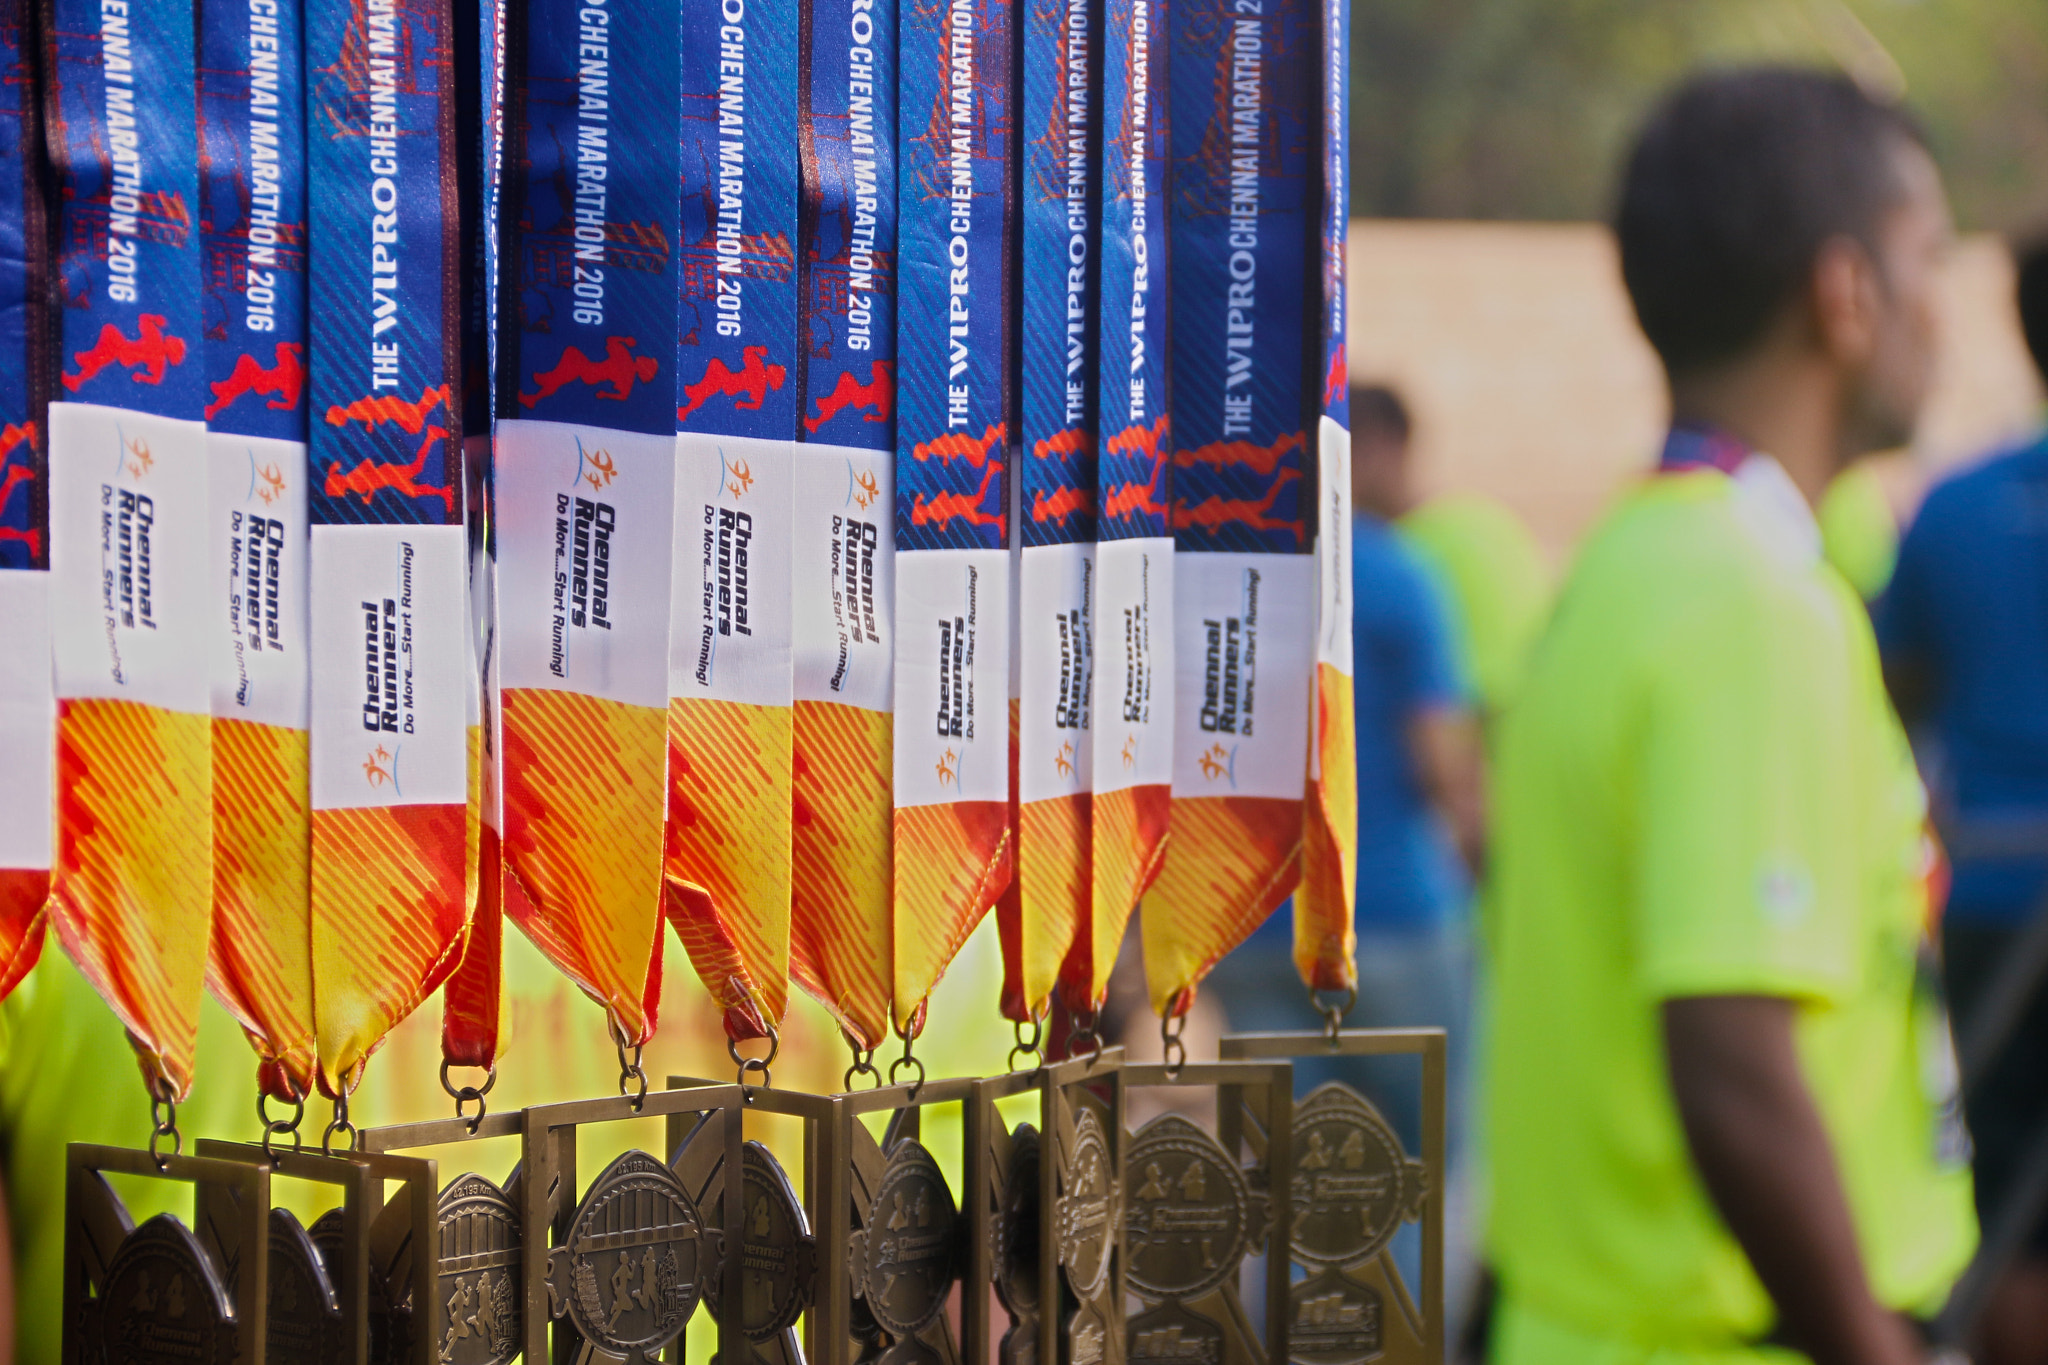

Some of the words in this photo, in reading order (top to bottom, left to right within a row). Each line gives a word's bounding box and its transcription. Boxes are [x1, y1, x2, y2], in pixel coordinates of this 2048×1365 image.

[101, 0, 133, 84] ENNAI
[248, 0, 279, 117] CHENNAI
[578, 8, 609, 120] CHENNAI
[719, 25, 745, 136] CHENNAI
[848, 46, 874, 155] CHENNAI
[951, 0, 973, 124] MARATHON
[1068, 0, 1087, 124] MARATHON
[1132, 0, 1148, 127] MARATHON
[1231, 19, 1262, 144] MARATHON
[105, 86, 140, 234] MARATHON
[369, 58, 398, 175] CHENNAI
[249, 120, 279, 265] MARATHON
[574, 124, 608, 262] MARATHON
[716, 140, 745, 274] MARATHON
[848, 158, 876, 290] MARATHON
[950, 127, 972, 233] CHENNAI
[1067, 129, 1087, 231] CHENNAI
[1131, 131, 1147, 232] CHENNAI
[1229, 148, 1259, 248] CHENNAI
[107, 237, 138, 303] 2016
[246, 269, 276, 332] 2016
[371, 177, 398, 338] WIPRO
[573, 266, 604, 326] 2016
[716, 278, 742, 337] 2016
[948, 235, 969, 381] WIPRO
[1067, 233, 1086, 376] WIPRO
[1130, 233, 1149, 375] WIPRO
[372, 341, 399, 390] THE
[847, 293, 872, 351] 2016
[1226, 250, 1256, 388] WIPRO
[948, 384, 969, 428] THE
[1066, 380, 1083, 424] THE
[1129, 378, 1146, 421] THE
[1224, 395, 1252, 436] THE
[101, 483, 112, 506] Do
[232, 510, 243, 532] Do
[556, 492, 570, 514] Do
[704, 504, 714, 525] Do
[832, 514, 842, 535] Do
[117, 488, 135, 630] Runners
[136, 493, 157, 630] Chennai
[247, 514, 266, 652] Runners
[266, 518, 284, 653] Chennai
[571, 496, 595, 629] Runners
[592, 502, 616, 631] Chennai
[718, 507, 735, 636] Runners
[735, 511, 752, 636] Chennai
[846, 517, 863, 644] Runners
[861, 521, 880, 644] Chennai
[362, 601, 380, 732] Chennai
[381, 598, 398, 734] Runners
[403, 713, 414, 735] Do
[937, 618, 951, 738] Chennai
[950, 616, 964, 738] Runners
[1068, 609, 1083, 729] Runners
[1219, 616, 1239, 734] Runners
[453, 1184, 479, 1199] 42.195
[479, 1184, 492, 1195] Km
[743, 1242, 784, 1260] hennai
[743, 1256, 786, 1274] unners
